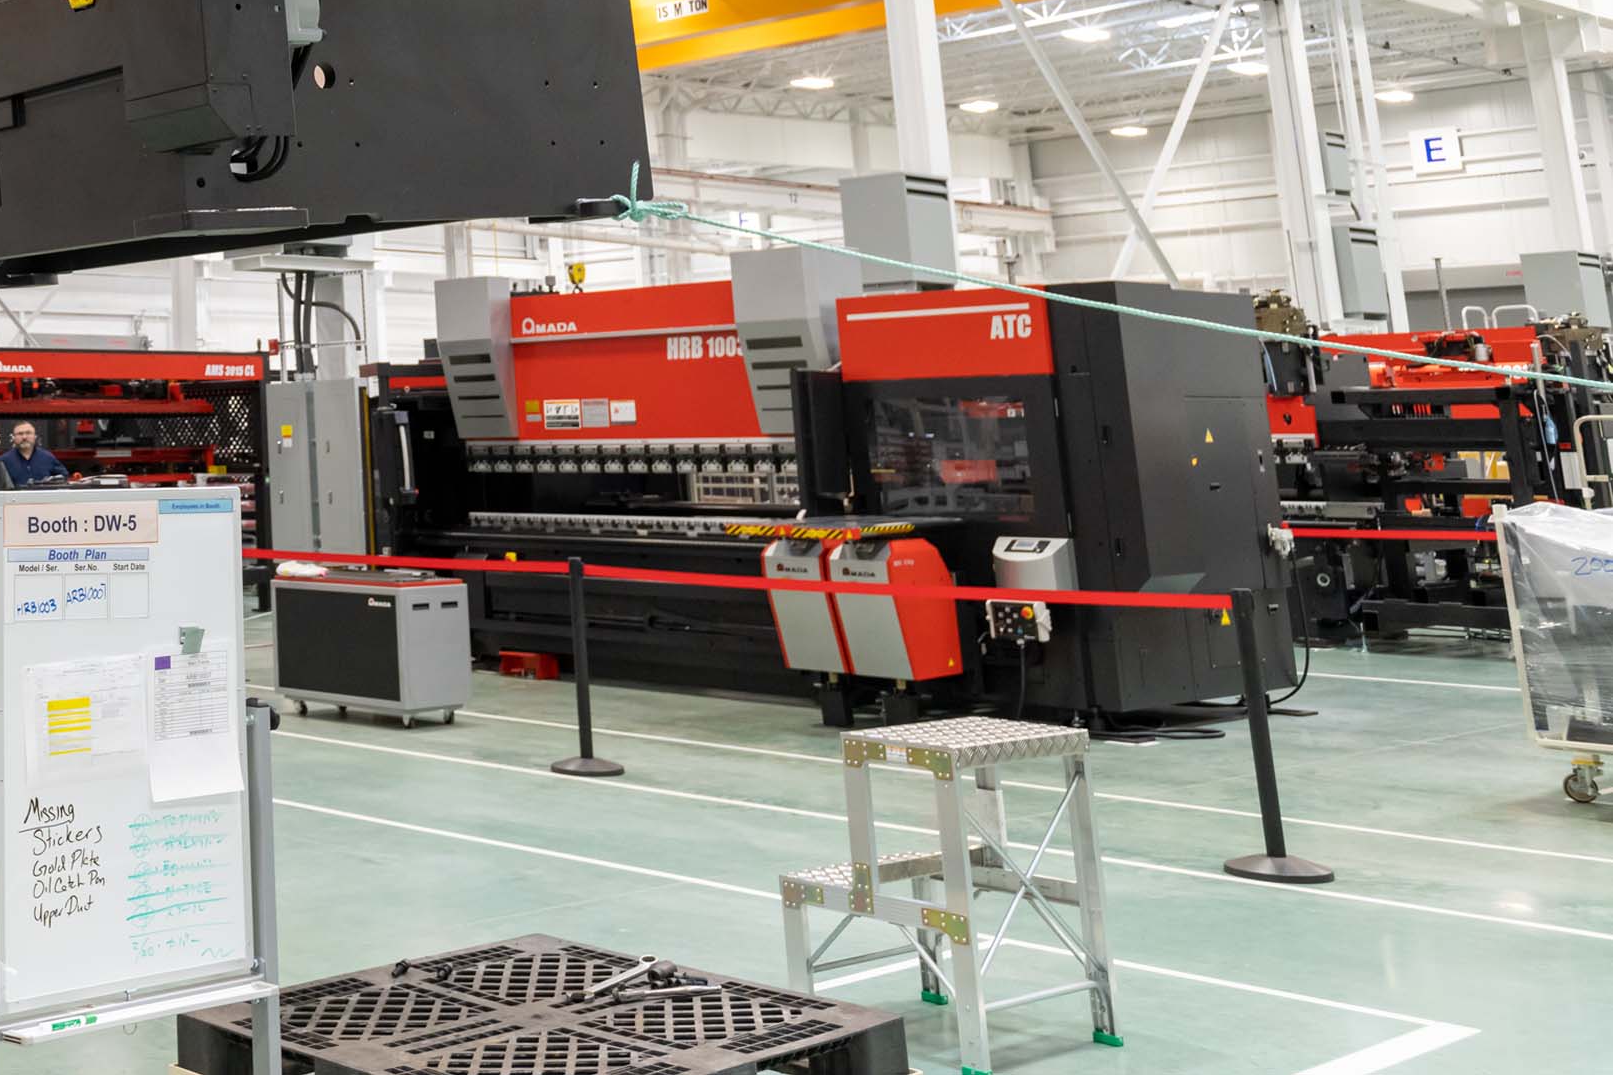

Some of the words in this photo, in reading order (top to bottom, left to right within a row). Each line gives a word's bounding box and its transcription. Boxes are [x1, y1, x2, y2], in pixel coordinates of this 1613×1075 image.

[674, 2, 683, 17] M
[1425, 137, 1447, 163] E
[522, 317, 578, 335] AMADA
[990, 313, 1032, 340] ATC
[666, 336, 703, 360] HRB
[28, 516, 77, 533] Booth
[94, 515, 137, 532] DW-5
[48, 549, 79, 561] Booth
[85, 549, 107, 560] Plan
[19, 564, 41, 572] Model
[45, 564, 60, 572] Ser.
[113, 563, 129, 571] Start
[130, 563, 146, 571] Date
[23, 797, 75, 824] Missing
[33, 825, 102, 856] Stickers
[32, 855, 66, 877] Gold
[33, 877, 52, 899] Oil
[33, 903, 64, 928] Upper
